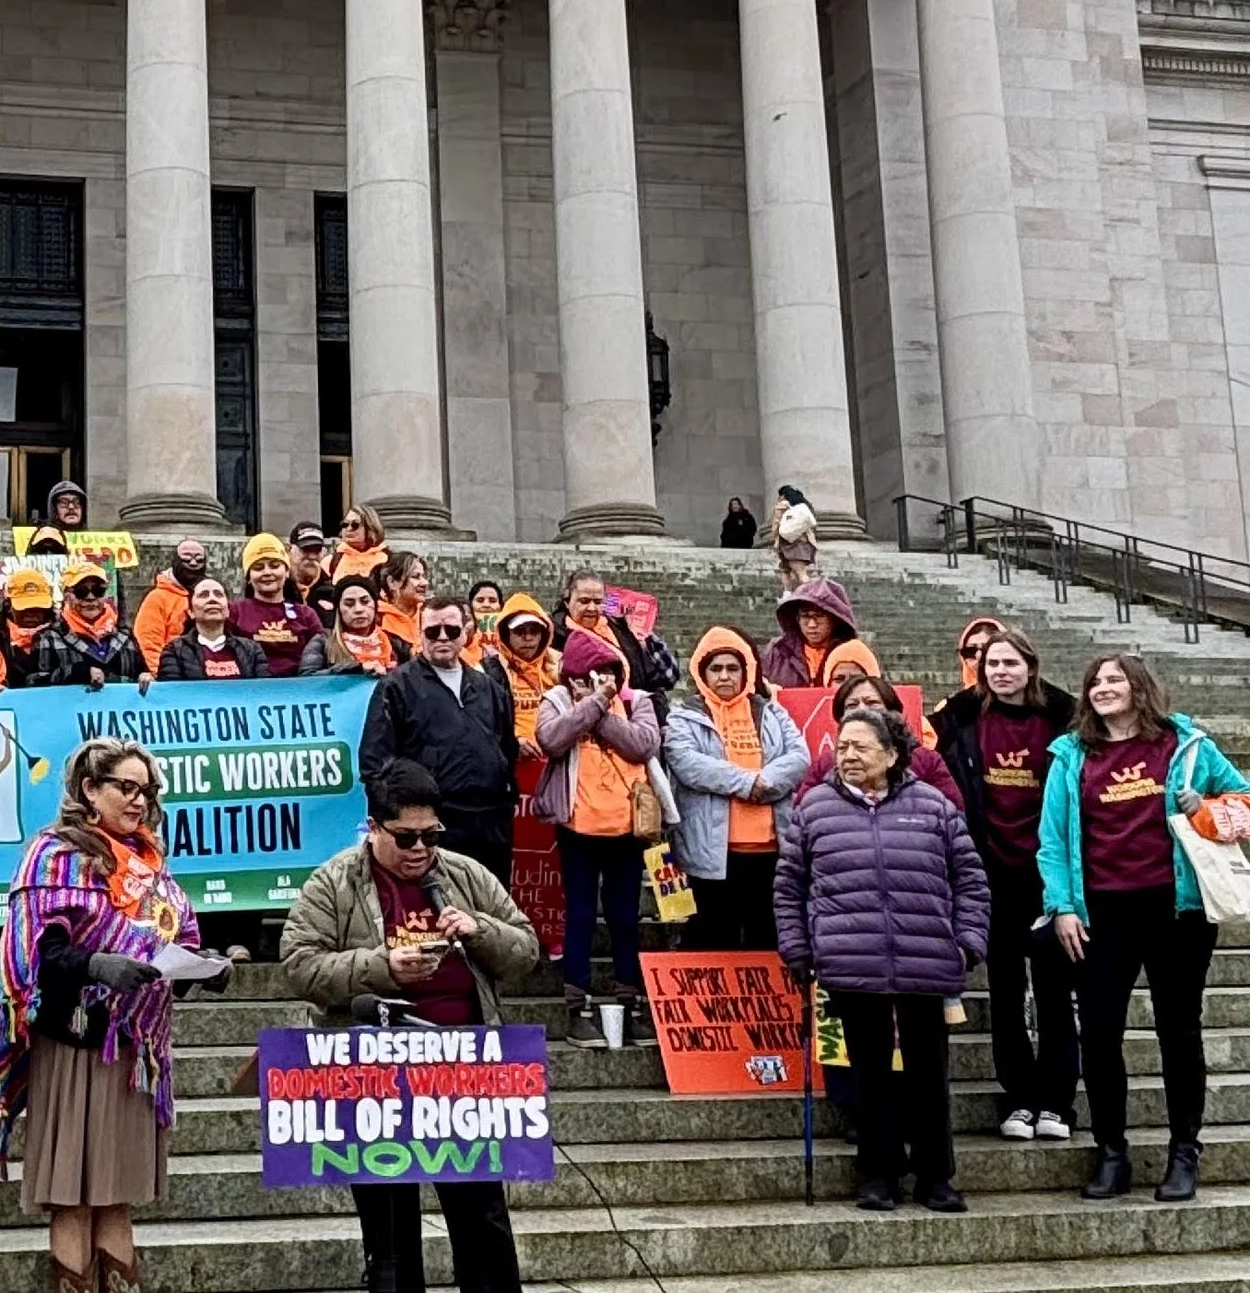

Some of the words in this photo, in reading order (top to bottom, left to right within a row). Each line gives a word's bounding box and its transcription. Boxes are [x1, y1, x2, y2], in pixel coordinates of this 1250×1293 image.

[78, 707, 250, 744] WASHINGTON
[257, 703, 335, 739] STATE
[219, 748, 342, 791] WORKERS
[162, 803, 300, 858] ALITION
[510, 859, 561, 887] ludin
[650, 967, 667, 996] I
[670, 967, 730, 996] SUPPORT
[734, 966, 775, 996] FAIR
[653, 999, 692, 1025] FAIR
[696, 993, 795, 1024] WORKPLACES
[306, 1032, 351, 1065] WE
[358, 1031, 477, 1064] DESERVE
[483, 1031, 502, 1062] A
[666, 1025, 739, 1052] DOMESTIC
[744, 1022, 806, 1052] WORKE
[267, 1065, 401, 1100] DOMESTIC
[405, 1062, 546, 1098] WORKERS
[268, 1099, 344, 1144] BILL
[355, 1097, 402, 1142] OF
[411, 1095, 549, 1141] RIGHTS
[311, 1140, 503, 1176] NOW!
